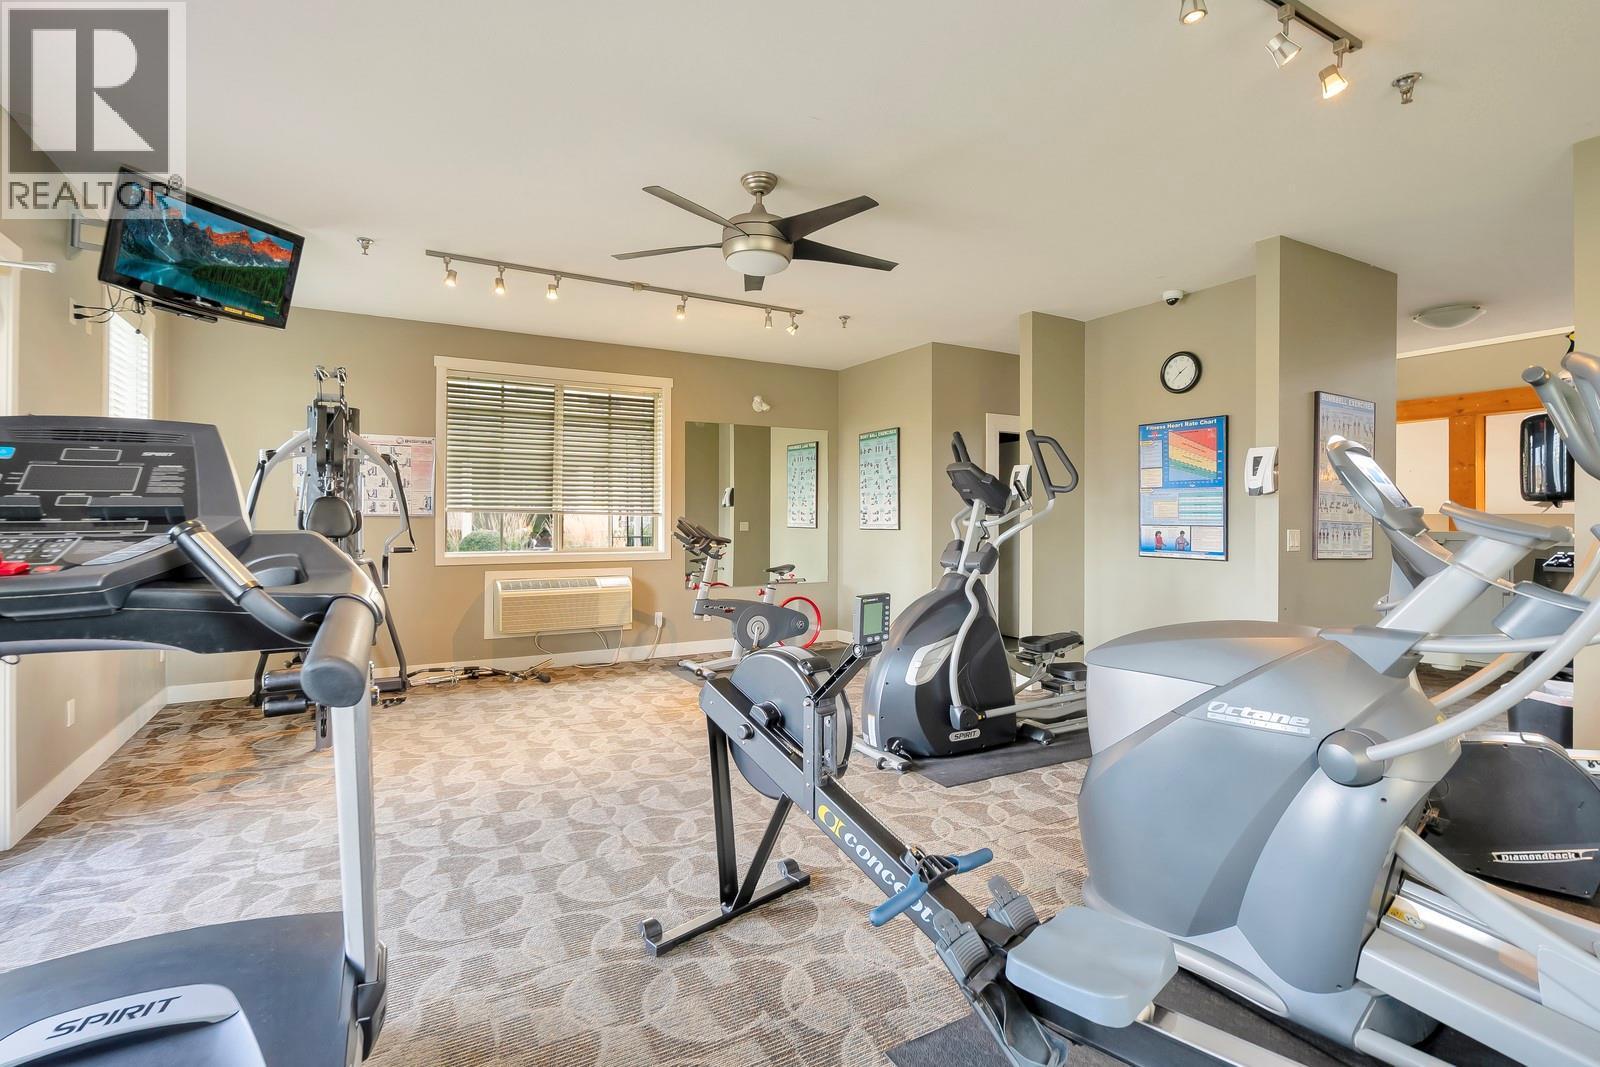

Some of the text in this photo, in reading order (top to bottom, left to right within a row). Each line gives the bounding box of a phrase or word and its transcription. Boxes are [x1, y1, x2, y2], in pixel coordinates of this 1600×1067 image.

[1207, 701, 1310, 727] Octane
[954, 731, 977, 740] SPIRIT
[1501, 852, 1575, 861] Diamondback
[45, 995, 184, 1040] SPIRIT
